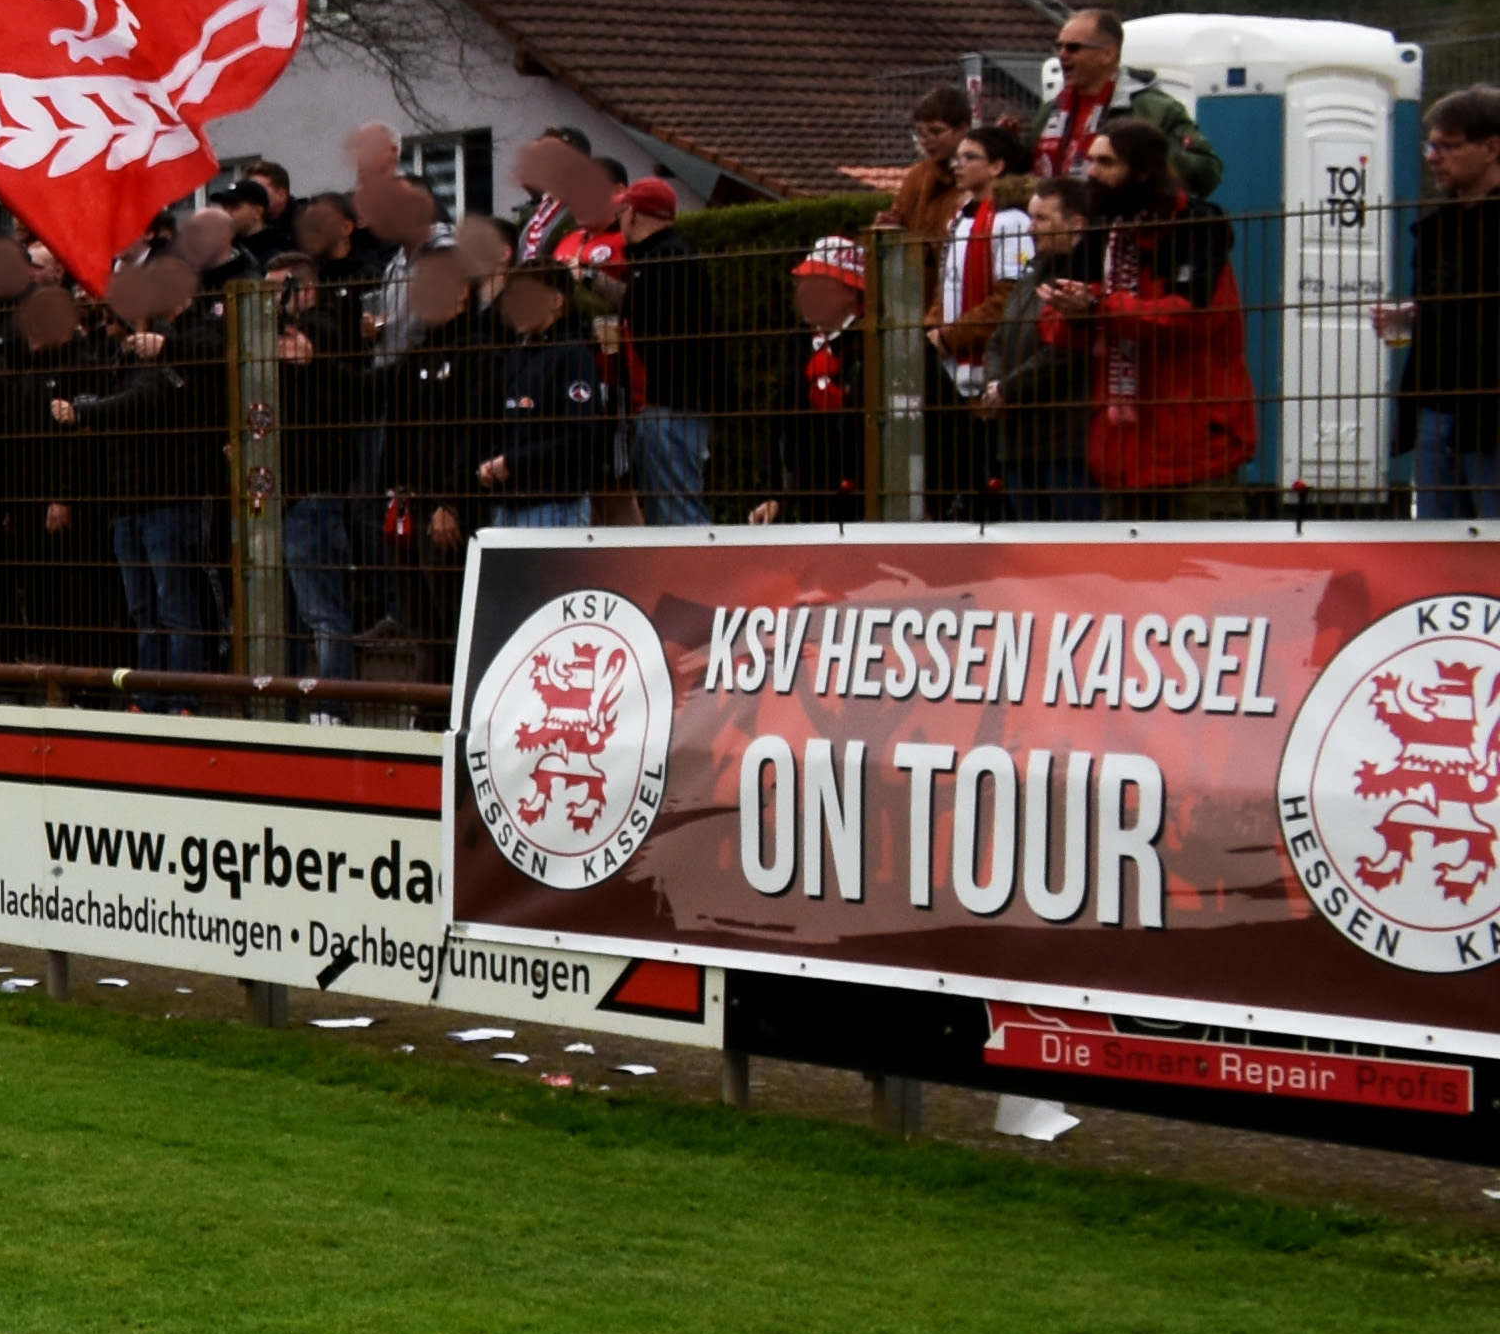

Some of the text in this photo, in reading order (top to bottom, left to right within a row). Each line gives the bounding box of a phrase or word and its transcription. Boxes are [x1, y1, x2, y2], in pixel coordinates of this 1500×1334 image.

[562, 593, 618, 622] KSV
[706, 604, 1277, 719] KSV HESSEN KASSEL
[44, 820, 442, 907] www.gerber-da
[469, 749, 548, 880] HESSEN
[582, 763, 664, 882] KASSEL
[739, 734, 1166, 932] ON TOUR
[1282, 794, 1402, 959] HESSEN
[308, 919, 591, 1001] Dachbegrünungen
[1040, 1033, 1091, 1067] Die
[1103, 1042, 1208, 1079] Smart
[1220, 1052, 1337, 1093] Repair
[1355, 1066, 1459, 1106] Profis
